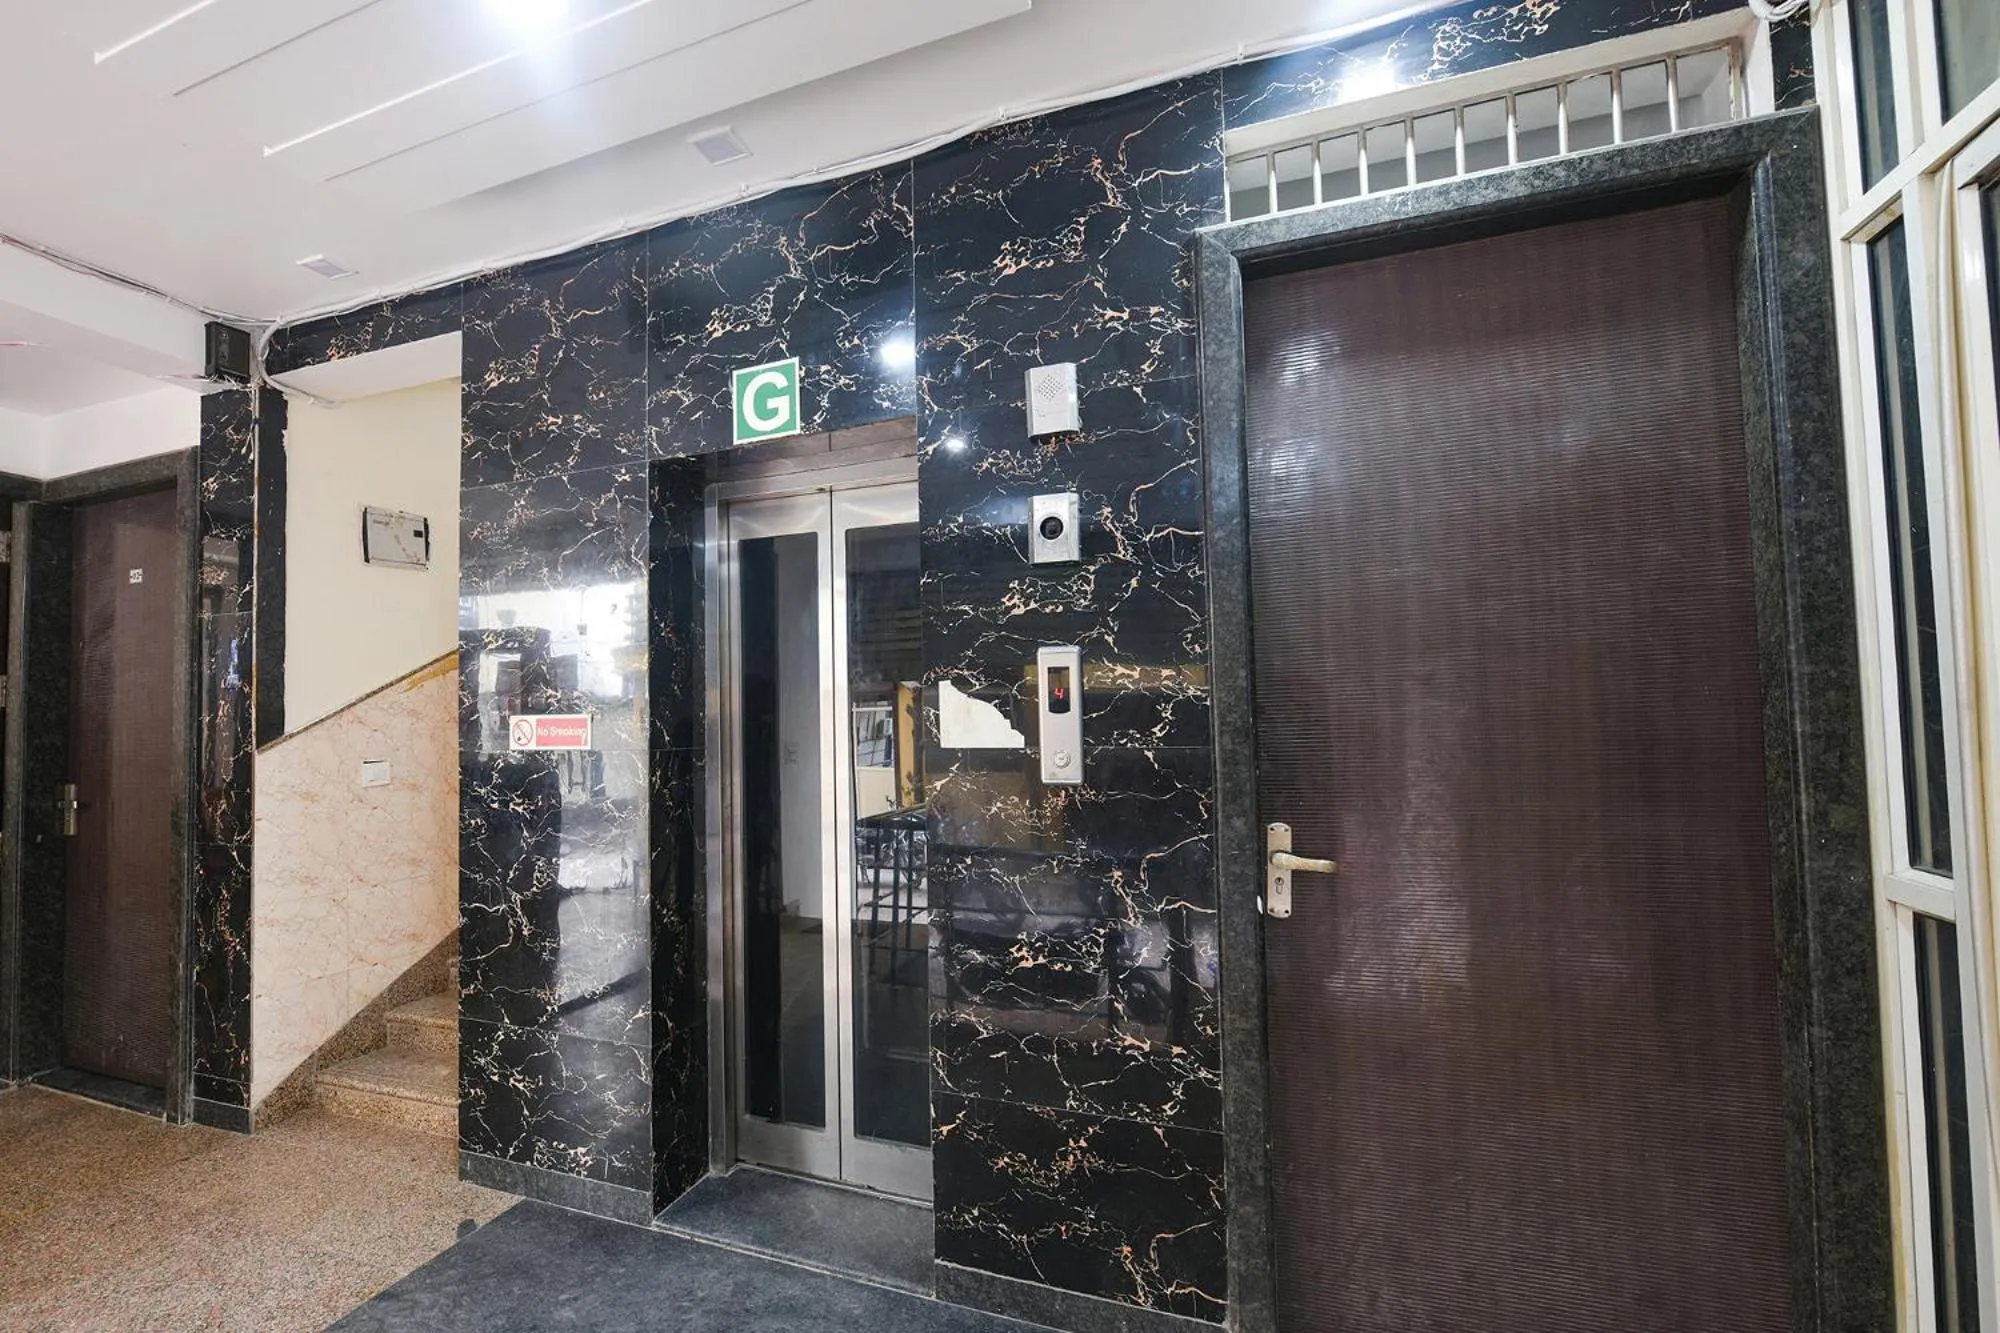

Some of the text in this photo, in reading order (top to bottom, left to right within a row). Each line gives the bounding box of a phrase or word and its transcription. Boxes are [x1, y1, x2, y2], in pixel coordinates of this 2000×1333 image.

[742, 371, 790, 432] G
[1054, 687, 1064, 700] 4
[537, 725, 587, 746] No Smoking
